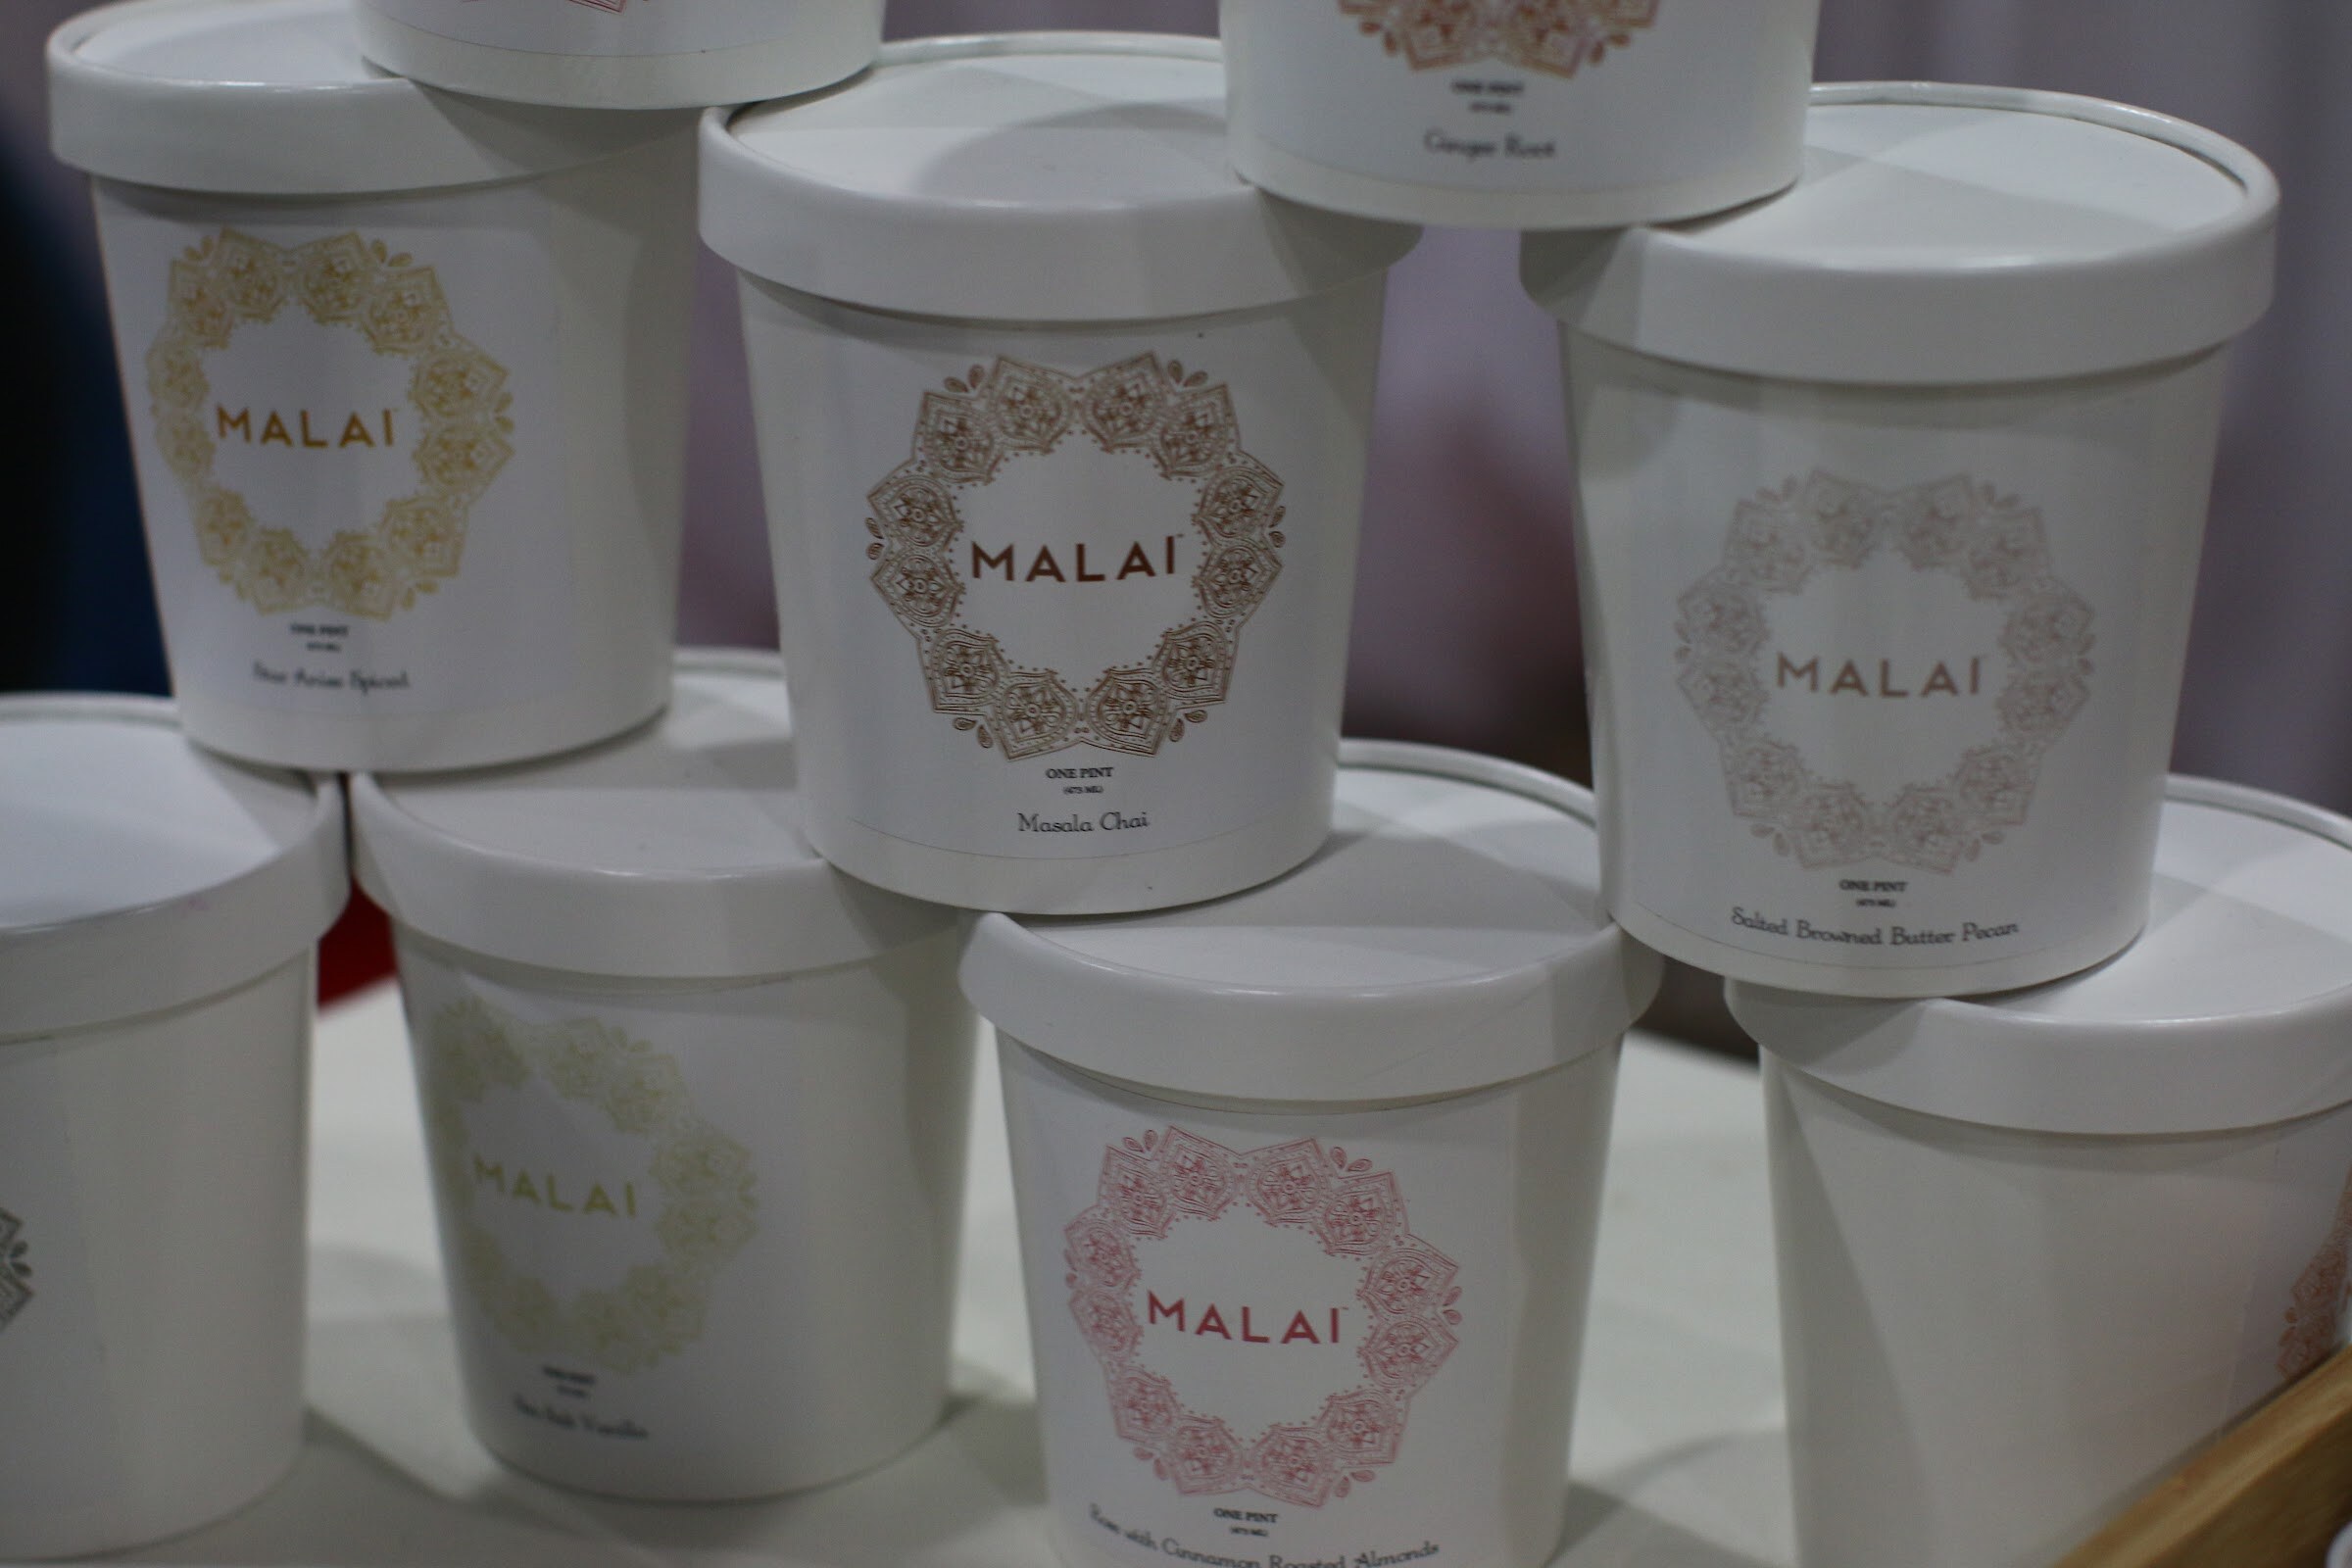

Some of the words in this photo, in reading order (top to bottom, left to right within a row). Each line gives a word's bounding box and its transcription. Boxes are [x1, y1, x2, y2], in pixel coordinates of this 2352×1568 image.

[216, 403, 394, 449] MALAI
[971, 535, 1174, 583] MALAI
[1777, 652, 1980, 698] MALAI
[1046, 768, 1077, 779] ONE
[1079, 766, 1114, 778] PINT
[1017, 812, 1094, 833] Masala
[1100, 811, 1151, 831] Chai
[1732, 906, 1788, 936] Salted
[1796, 919, 1883, 946] Browned
[1889, 926, 1955, 946] Butter
[1962, 921, 2019, 942] Pecan
[473, 1154, 637, 1218] MALAI
[1148, 1289, 1340, 1344] MALAI
[1213, 1507, 1242, 1520] ONE
[1246, 1512, 1278, 1523] PINT
[1161, 1537, 1261, 1568] Cinnamon
[1354, 1541, 1440, 1568] Almonds
